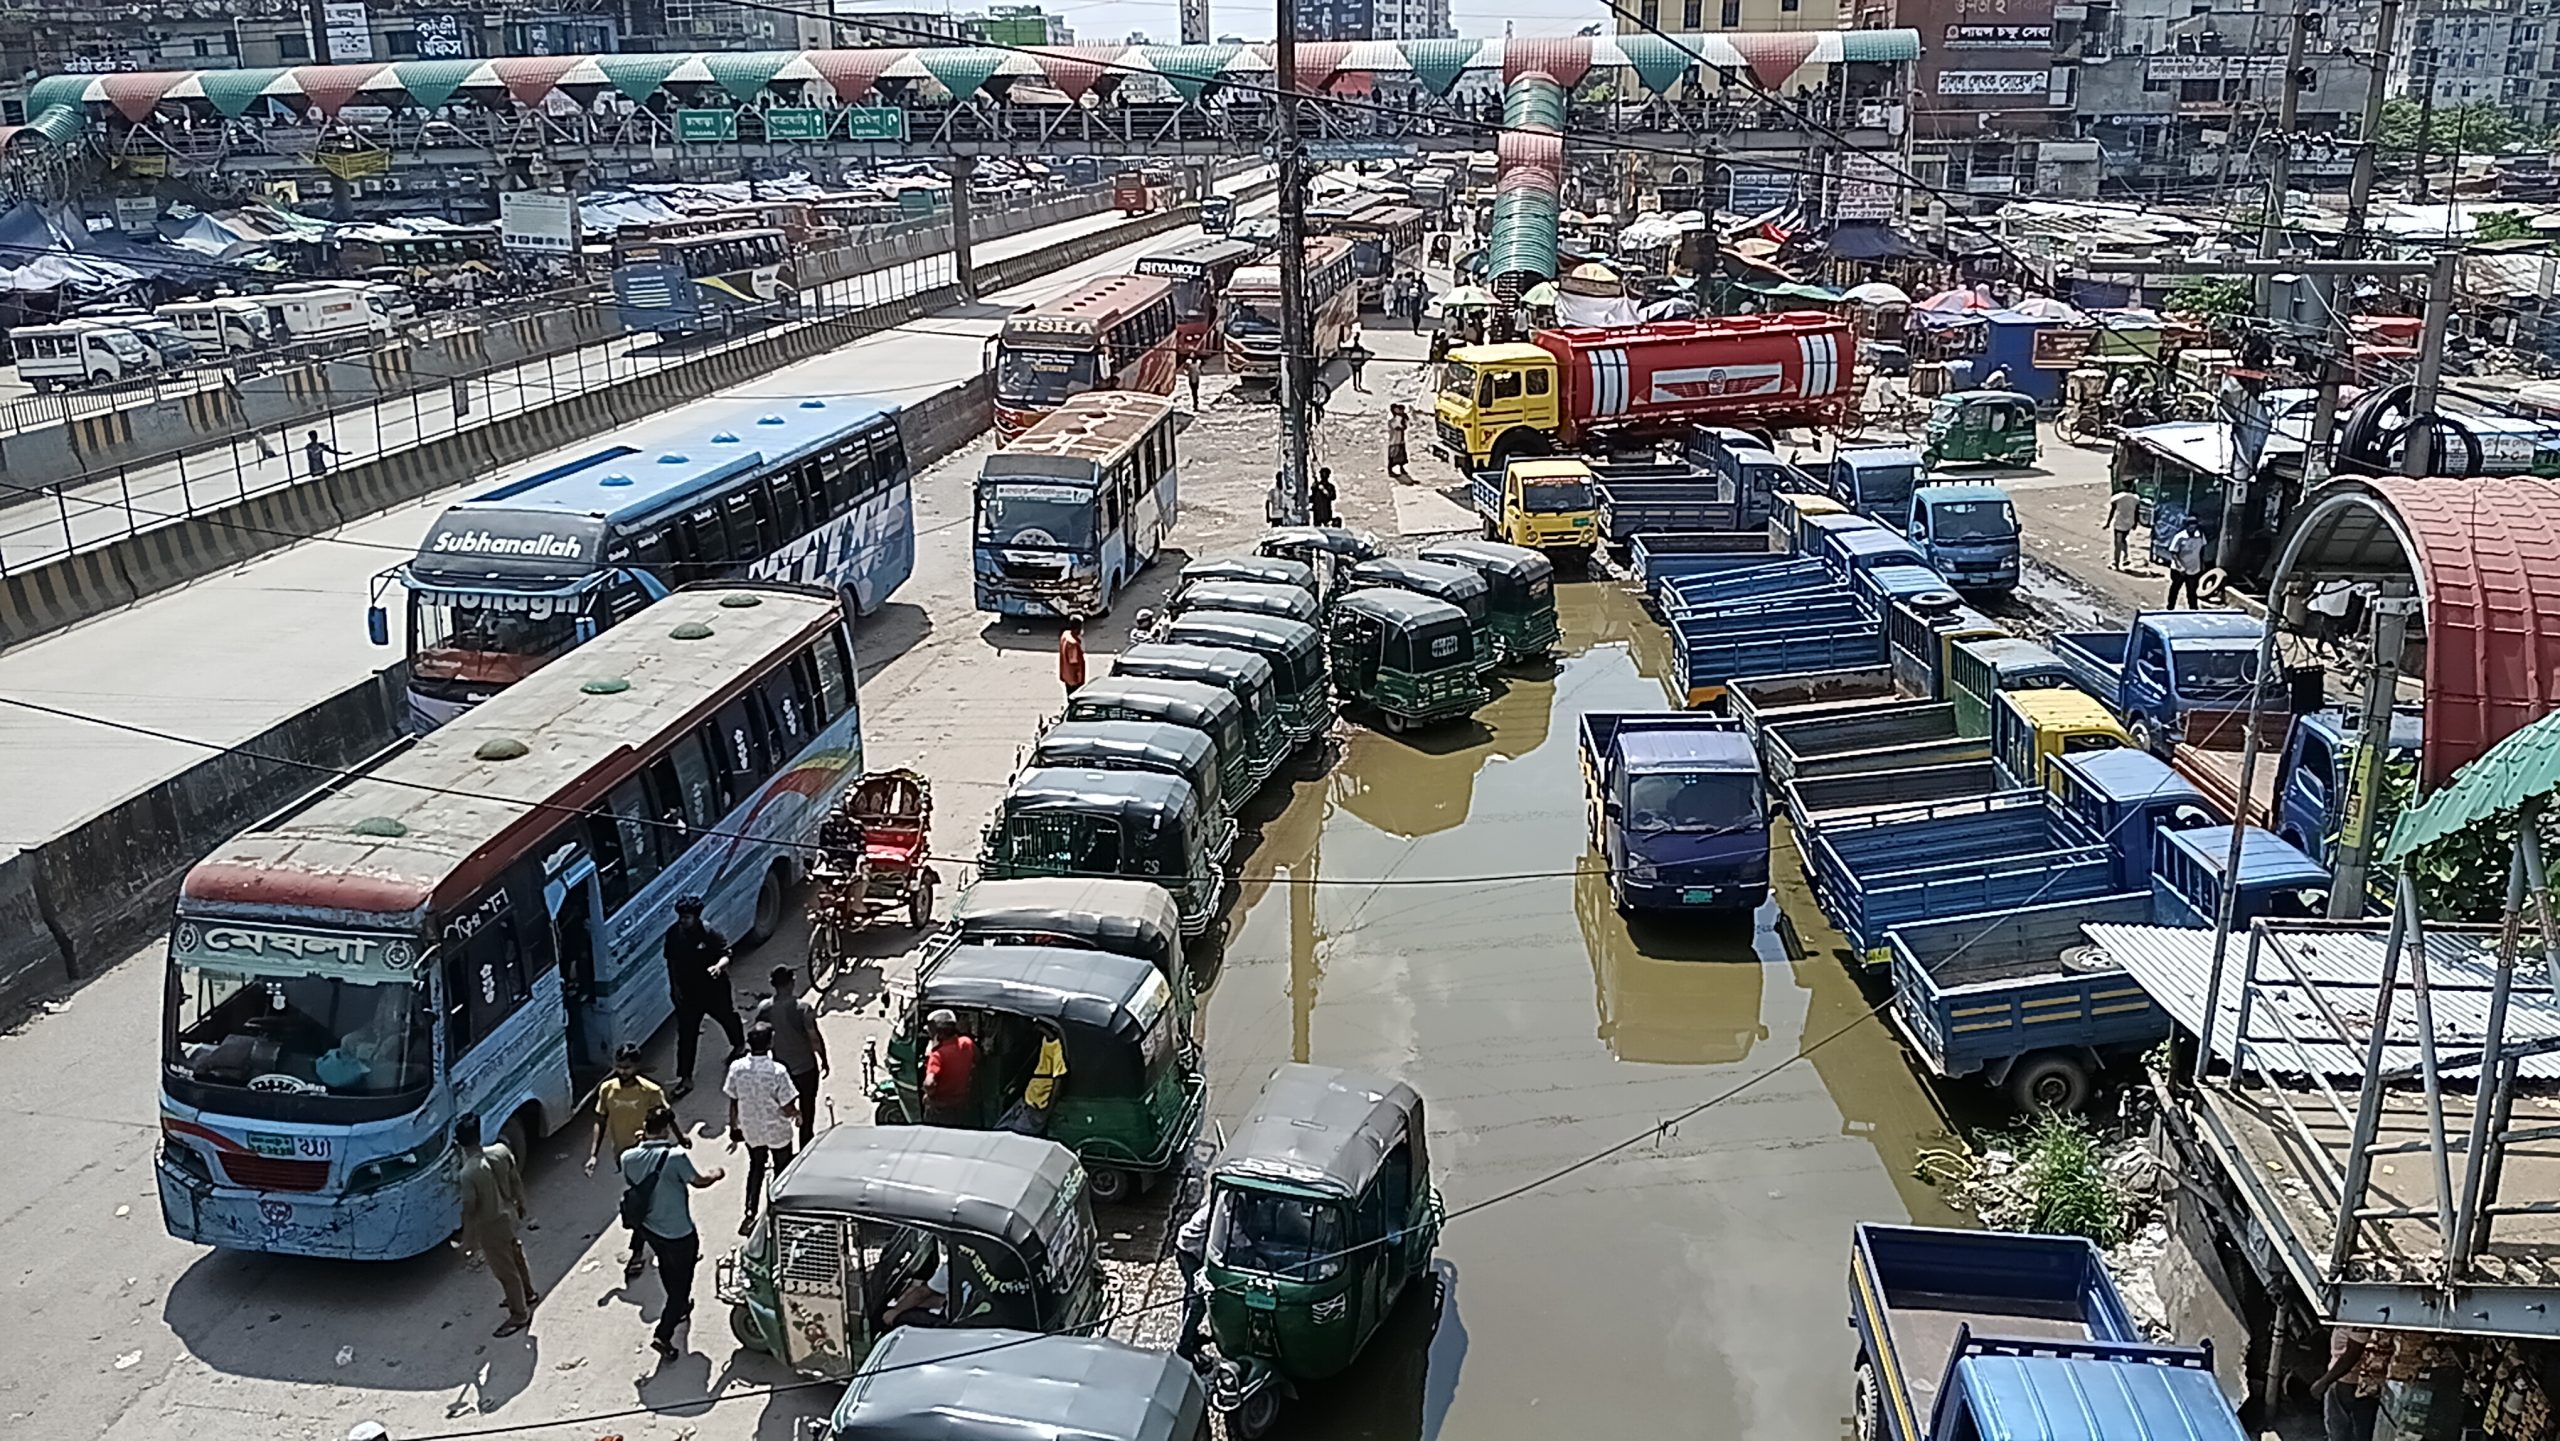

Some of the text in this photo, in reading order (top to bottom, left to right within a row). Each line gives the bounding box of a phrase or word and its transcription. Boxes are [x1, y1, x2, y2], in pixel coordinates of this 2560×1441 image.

[1140, 261, 1201, 276] SHYAMOLI
[1008, 319, 1094, 334] TISHA
[432, 531, 582, 558] Subhanallah
[205, 927, 379, 963] মেঘলা
